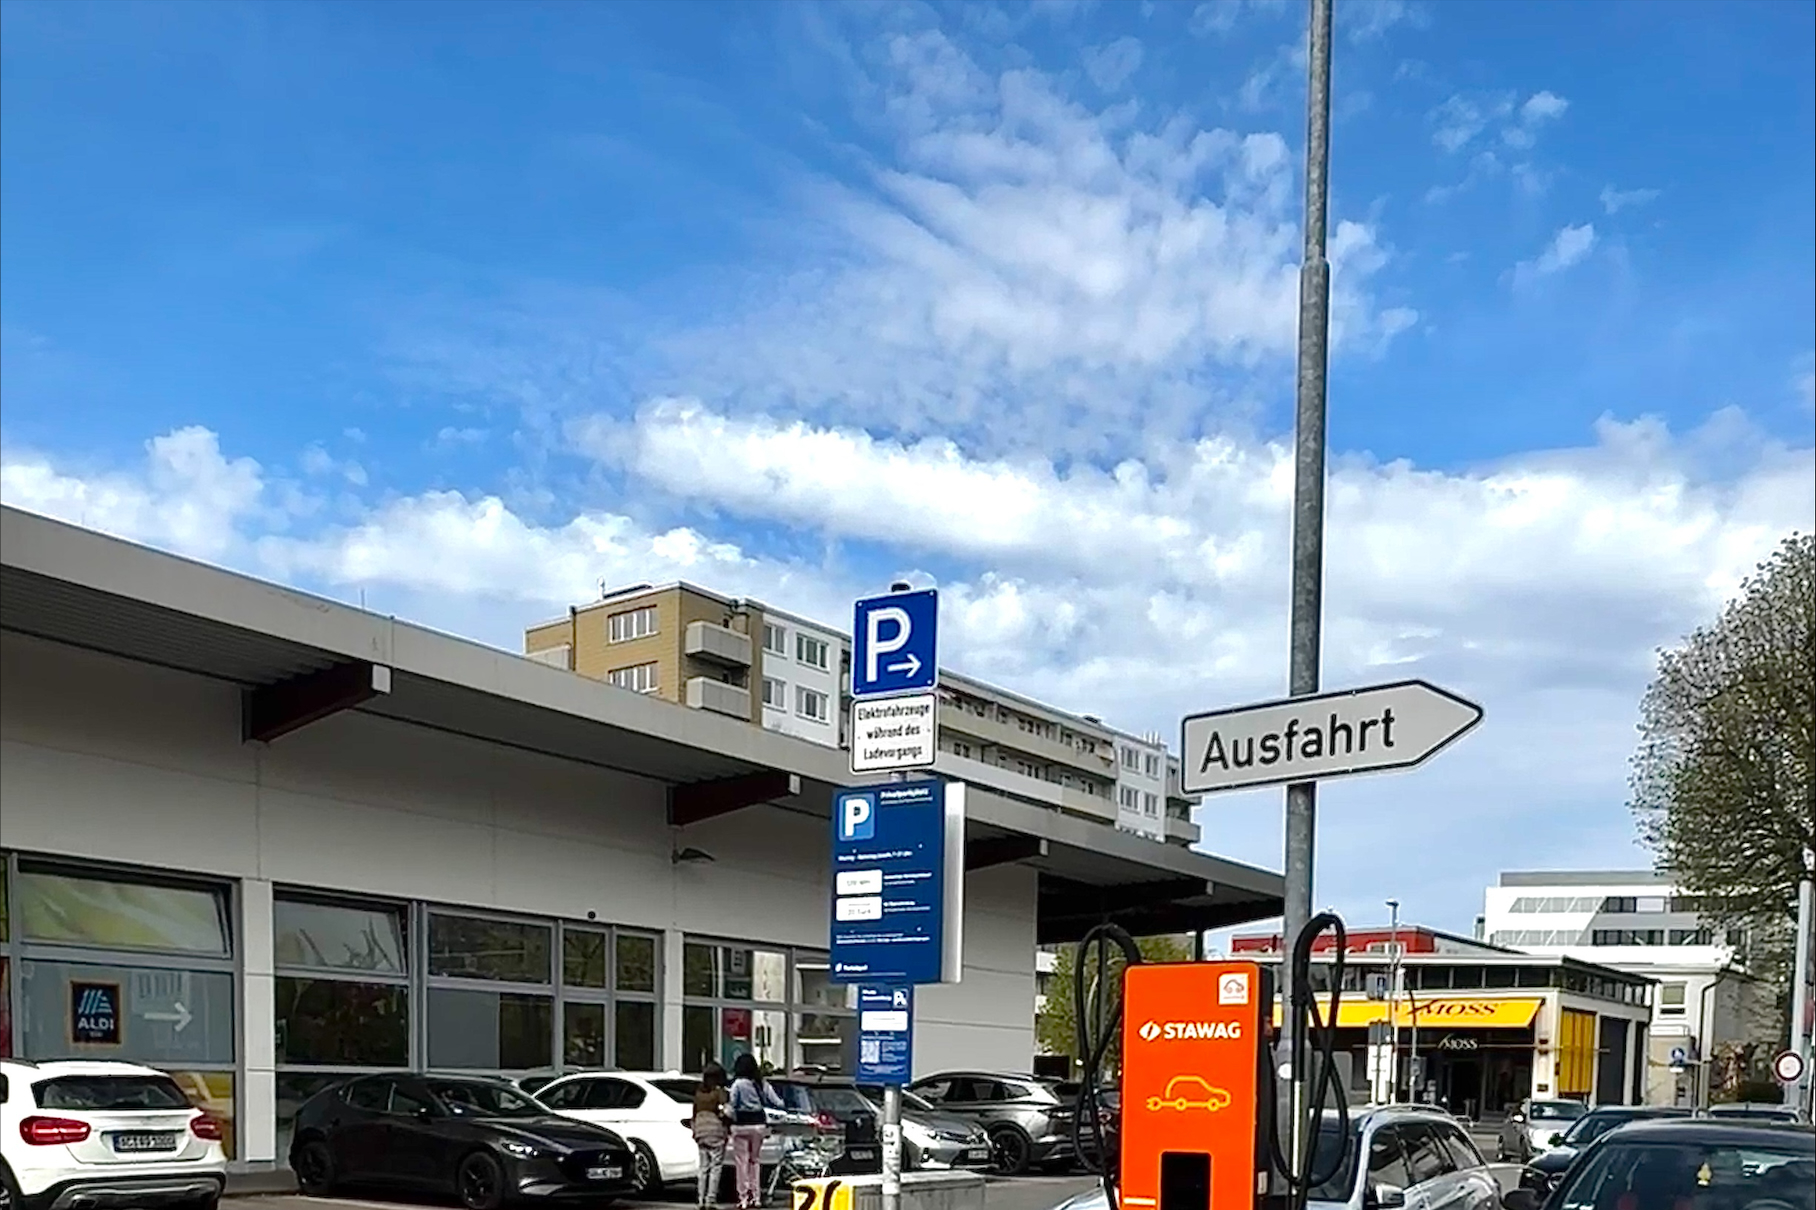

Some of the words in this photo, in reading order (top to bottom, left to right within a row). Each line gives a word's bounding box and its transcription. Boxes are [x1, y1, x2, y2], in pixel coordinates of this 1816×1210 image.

[866, 607, 911, 682] P
[858, 704, 930, 720] Elektrofahrzeuge
[866, 725, 903, 739] während
[904, 724, 921, 736] des
[1200, 708, 1395, 773] Ausfahrt
[863, 746, 922, 760] Ladevorgangs
[844, 798, 870, 837] P
[78, 1017, 114, 1030] ALDI
[1163, 1021, 1241, 1039] STAWAG
